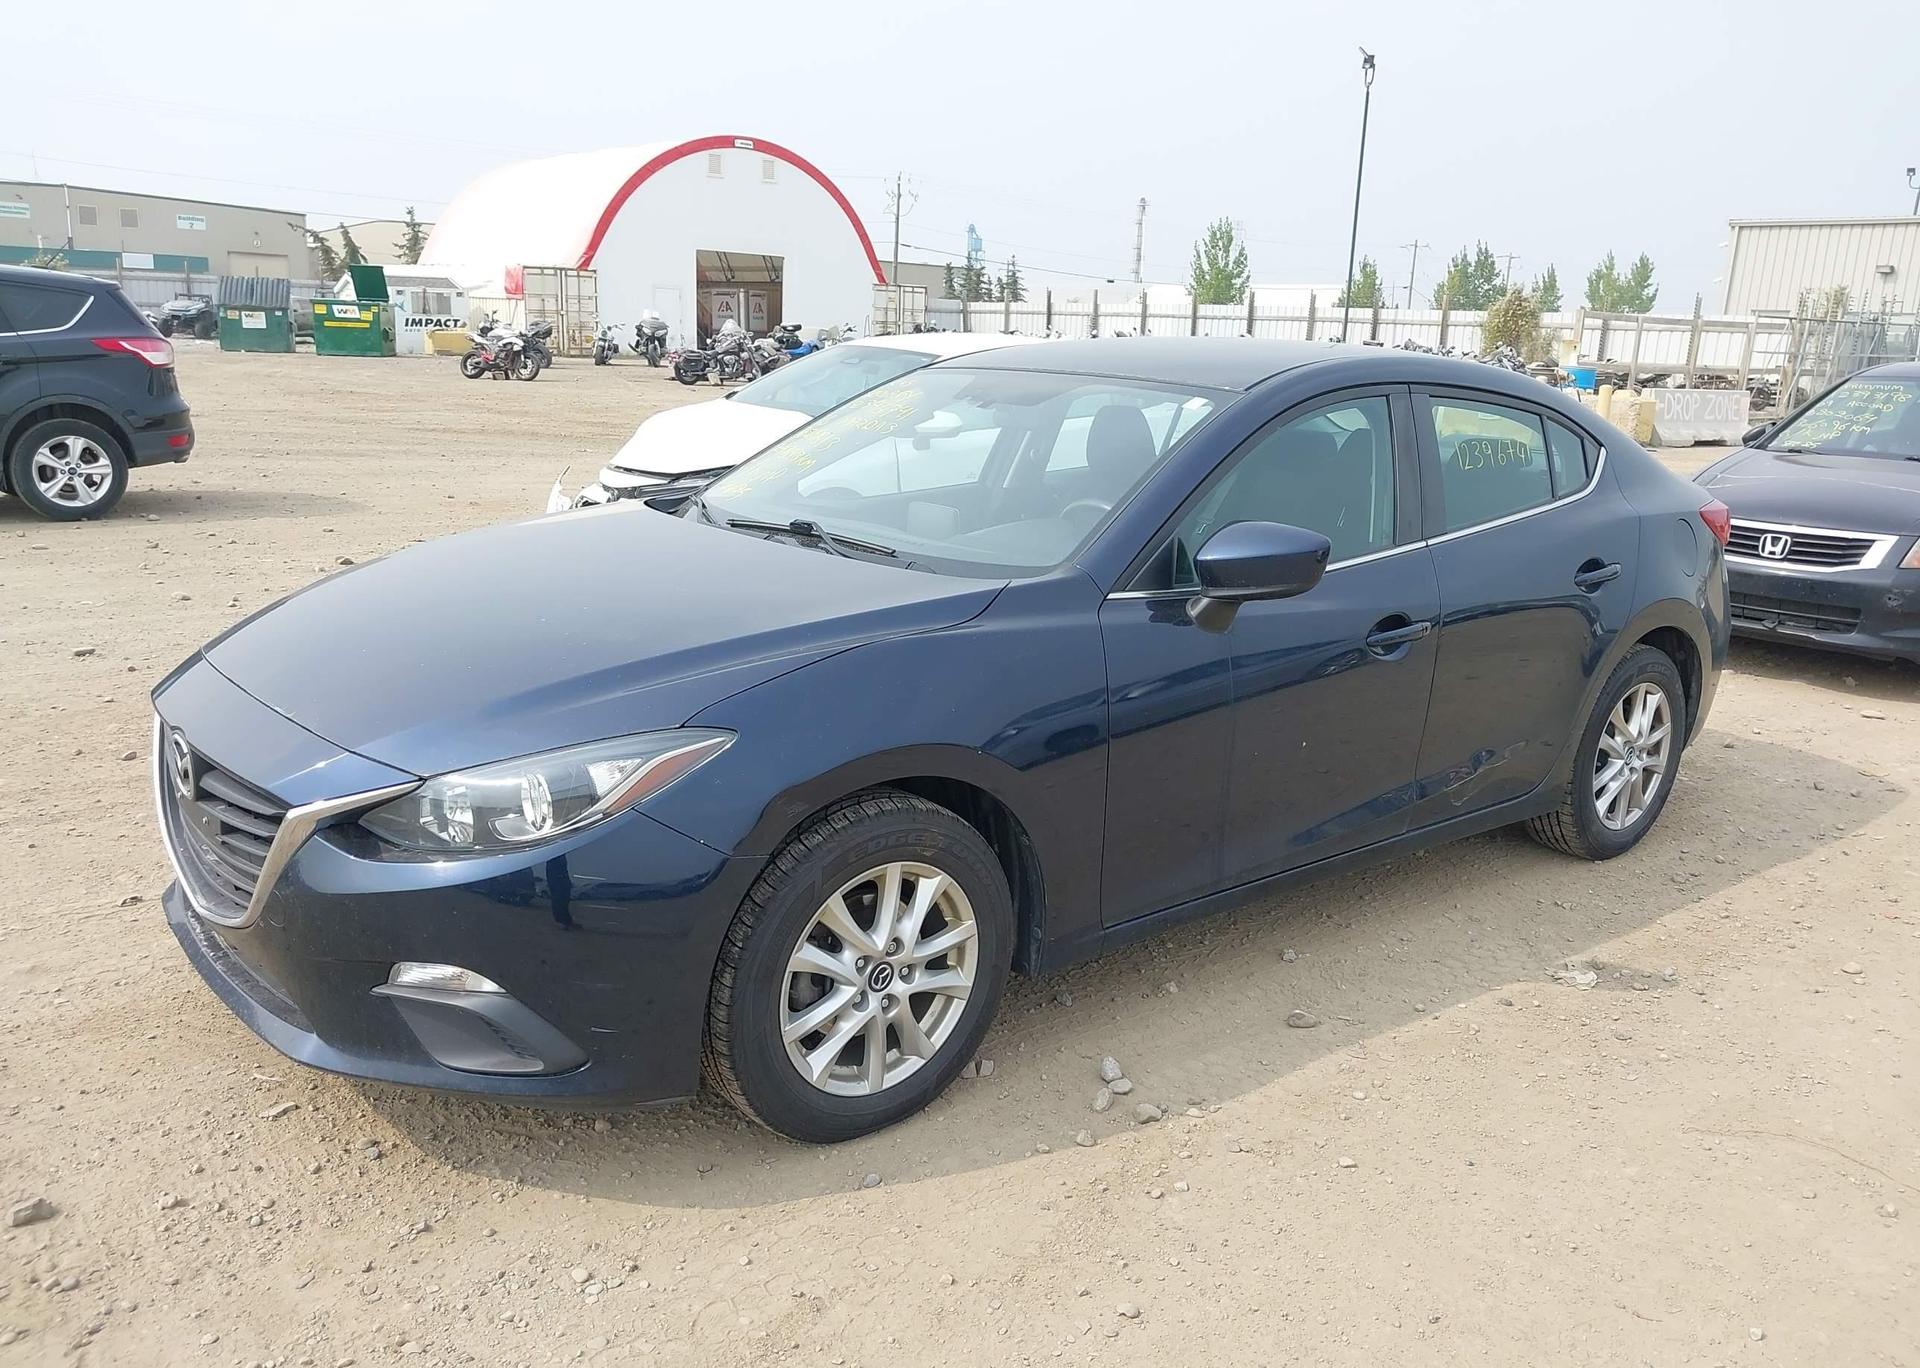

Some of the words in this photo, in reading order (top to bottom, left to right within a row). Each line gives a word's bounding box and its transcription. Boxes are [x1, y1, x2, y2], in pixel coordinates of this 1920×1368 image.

[404, 317, 461, 328] IMPACT
[1664, 392, 1700, 421] DROP
[1704, 394, 1740, 421] ZONE
[1454, 439, 1532, 471] 12396741
